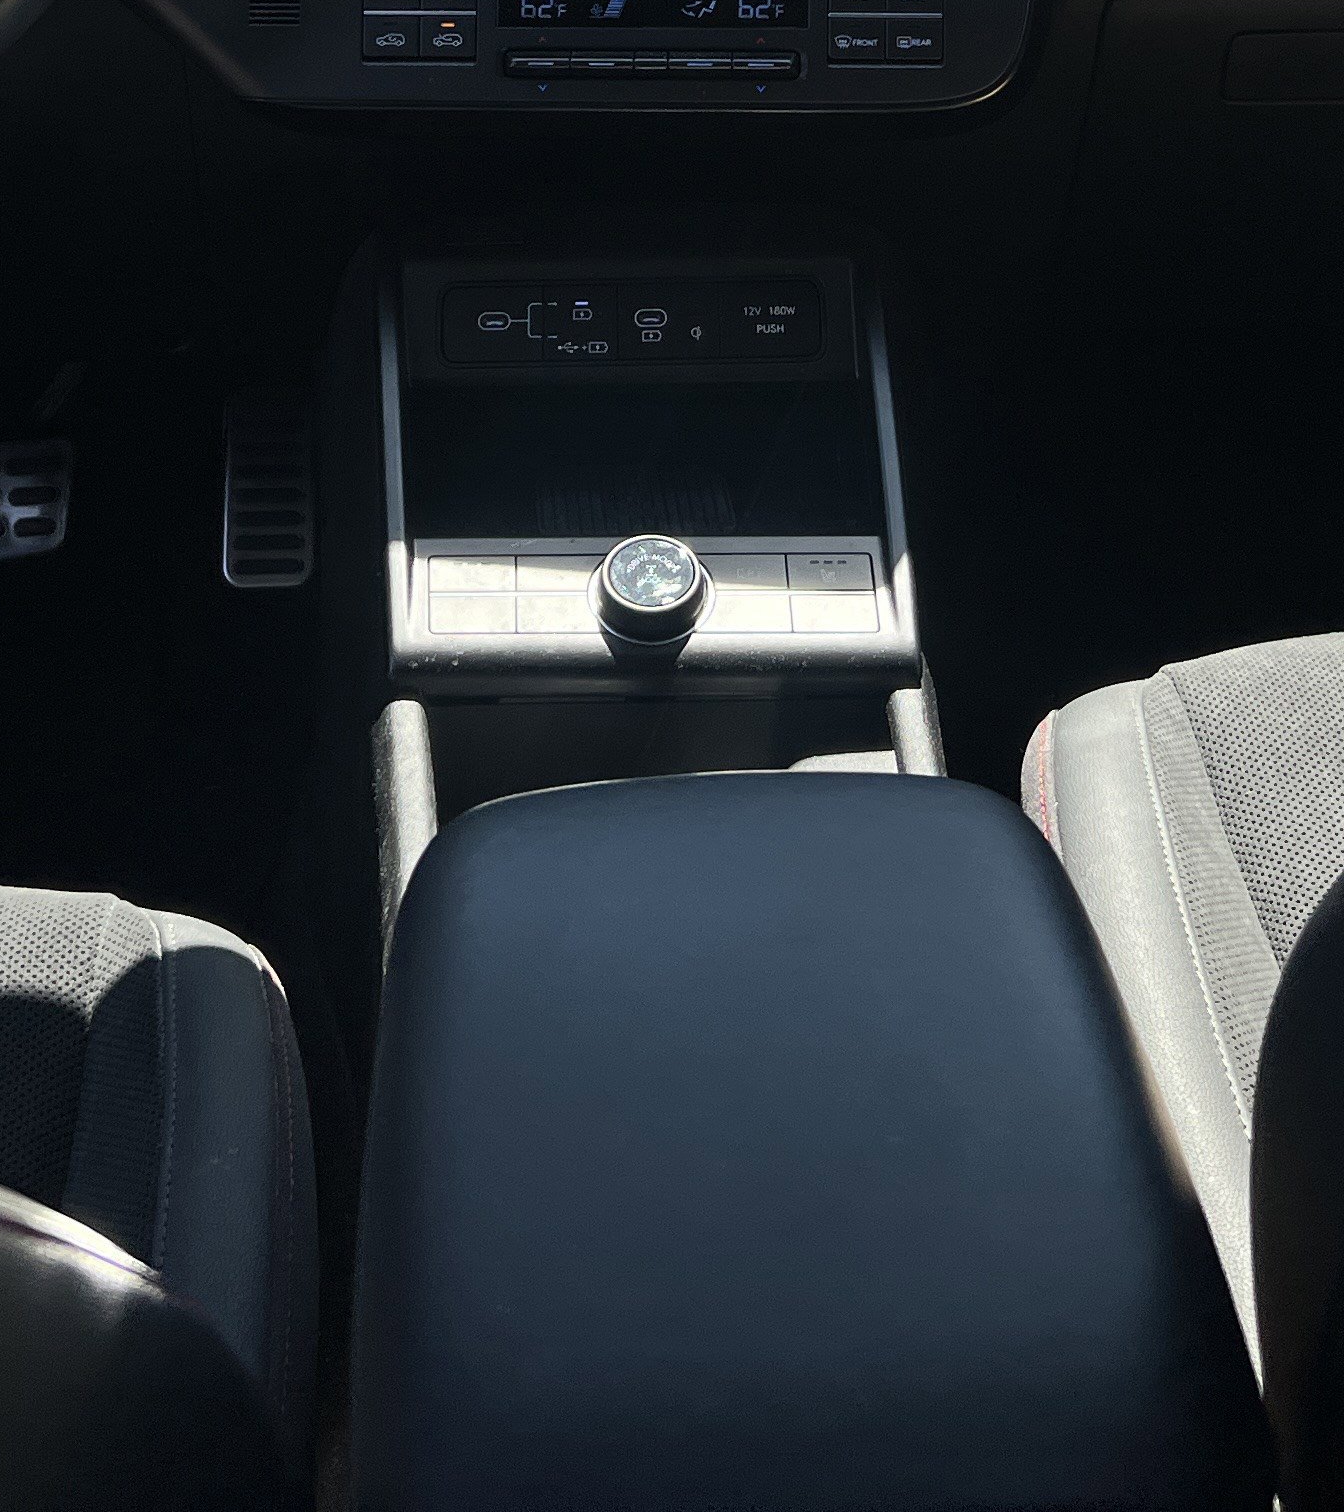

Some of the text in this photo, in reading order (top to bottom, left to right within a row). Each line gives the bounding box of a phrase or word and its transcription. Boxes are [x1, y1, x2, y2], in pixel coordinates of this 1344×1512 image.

[852, 39, 878, 47] FRONT
[743, 306, 761, 316] 12V
[756, 324, 785, 334] PUSH
